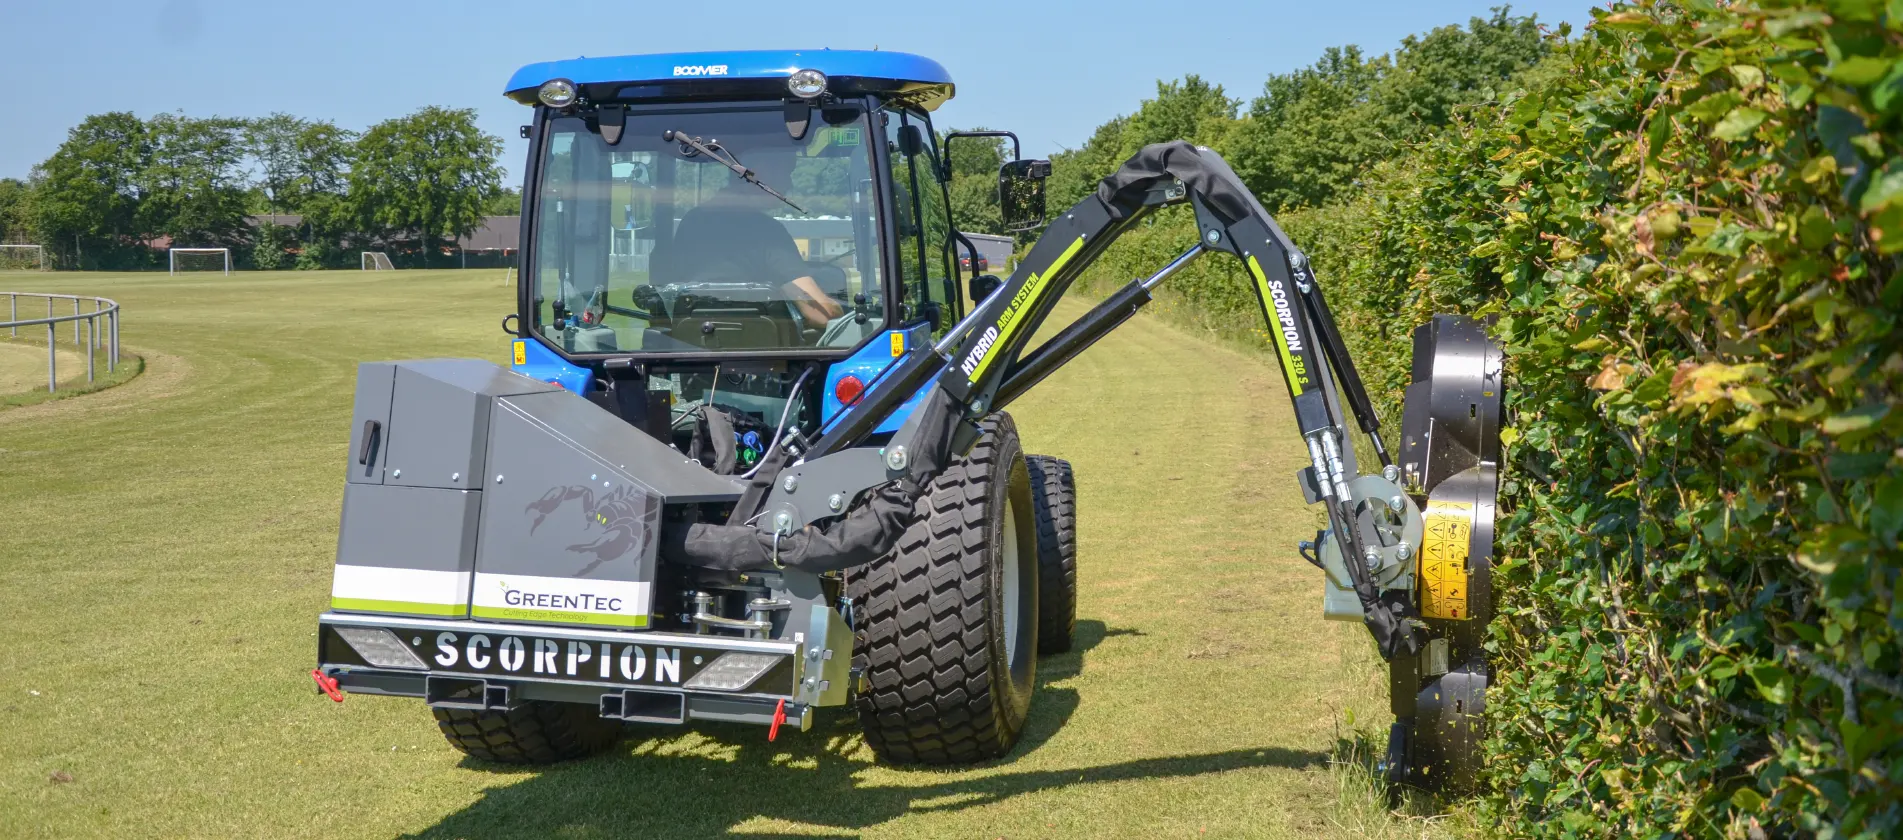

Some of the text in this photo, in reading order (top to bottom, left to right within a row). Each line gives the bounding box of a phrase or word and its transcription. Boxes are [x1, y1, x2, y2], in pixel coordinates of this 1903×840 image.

[673, 65, 728, 76] BOOMER
[961, 272, 1040, 376] HYBRID ARM SYSTEM
[1268, 280, 1303, 351] SCORPION
[1292, 355, 1306, 374] 330
[503, 608, 588, 621] Cutting Edge Technology
[434, 631, 681, 683] SCORPION
